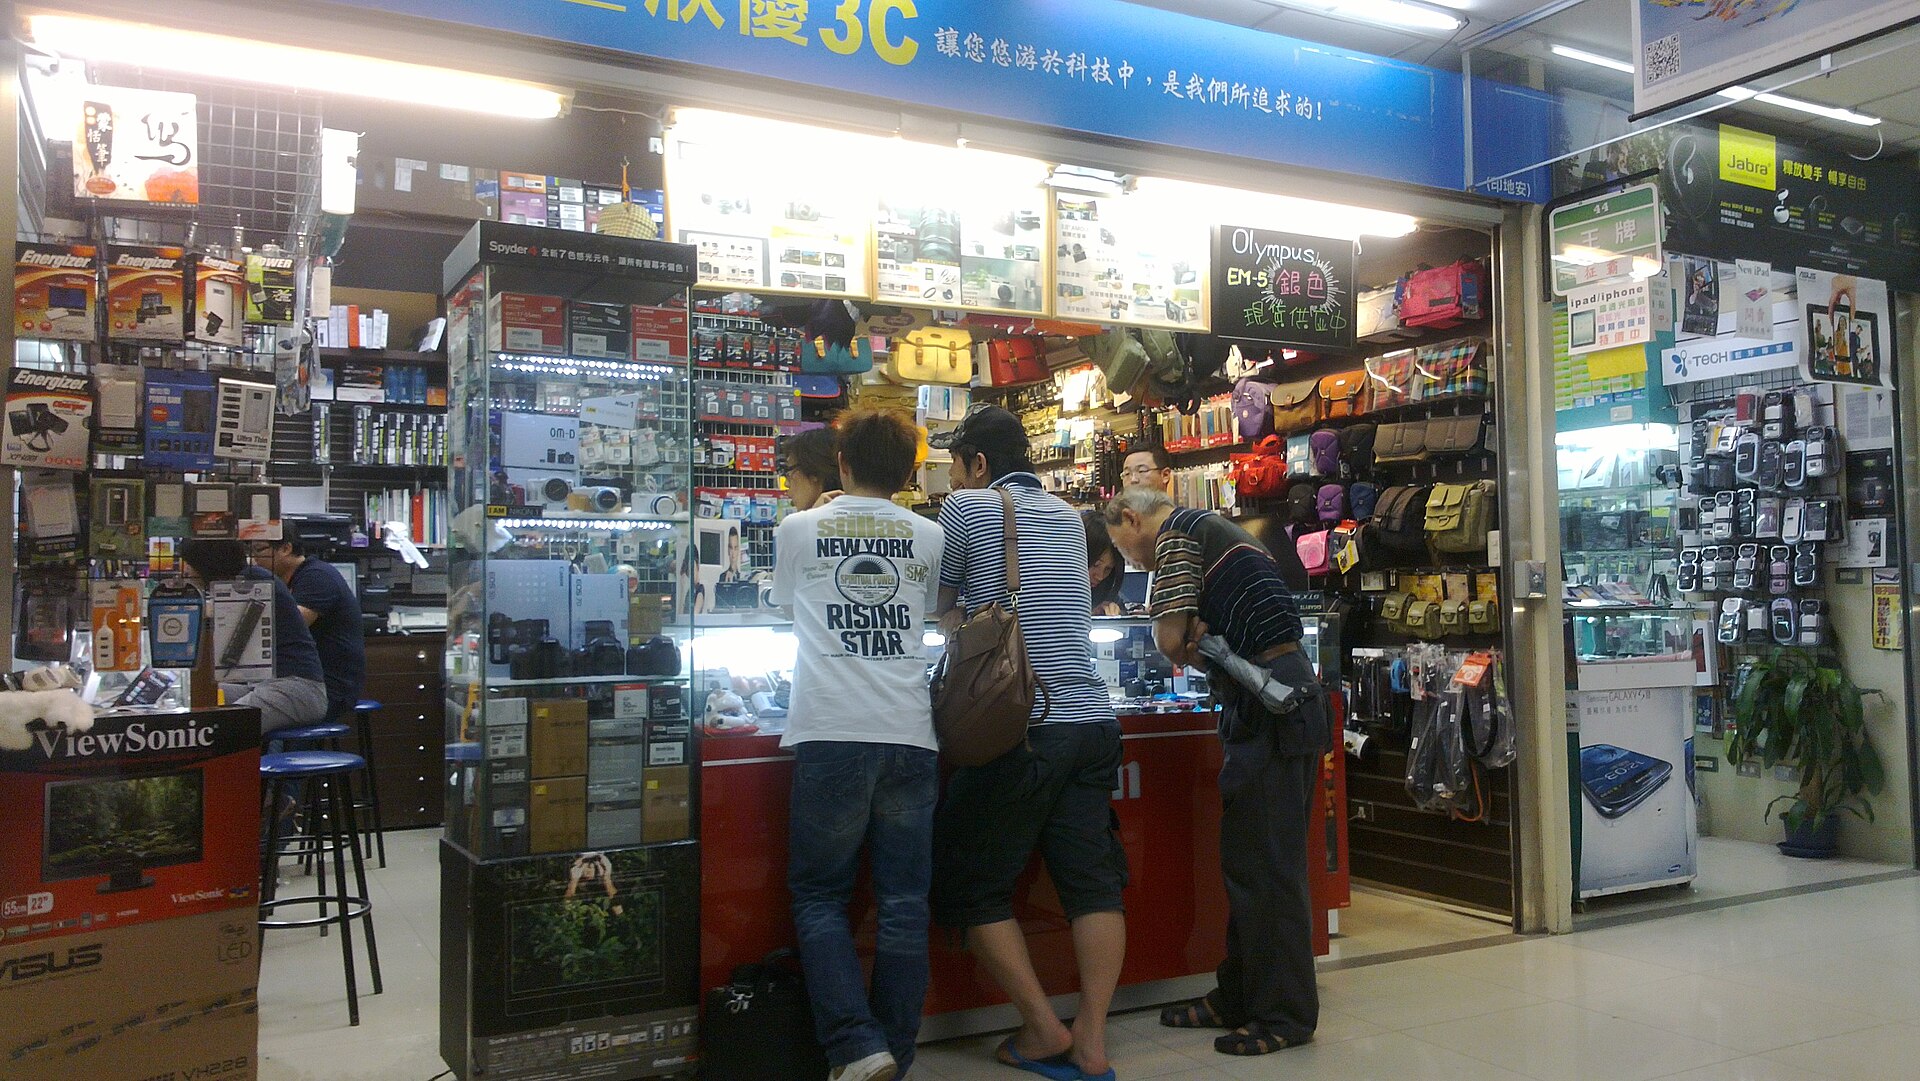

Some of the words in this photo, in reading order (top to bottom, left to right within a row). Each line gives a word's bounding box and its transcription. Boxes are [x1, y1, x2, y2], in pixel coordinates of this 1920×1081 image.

[1727, 154, 1768, 175] Jabra
[1593, 202, 1609, 214] 44
[1232, 228, 1315, 265] Olympus
[20, 249, 92, 268] Energizer
[116, 253, 177, 270] Energizer
[251, 256, 293, 269] POWER
[1738, 263, 1752, 275] New
[1754, 266, 1770, 278] iPad
[1227, 267, 1268, 287] EM-5
[1276, 269, 1326, 299] 銀色
[1571, 286, 1644, 308] ipad/iphone
[14, 369, 88, 390] Energizer
[817, 538, 860, 558] NEW
[862, 538, 914, 559] YORK
[841, 574, 872, 585] SPIRITUAL
[826, 603, 911, 630] RISING
[840, 630, 906, 657] STAR
[33, 719, 214, 760] ViewSonic
[171, 887, 225, 904] ViewSonic
[218, 941, 252, 963] LED
